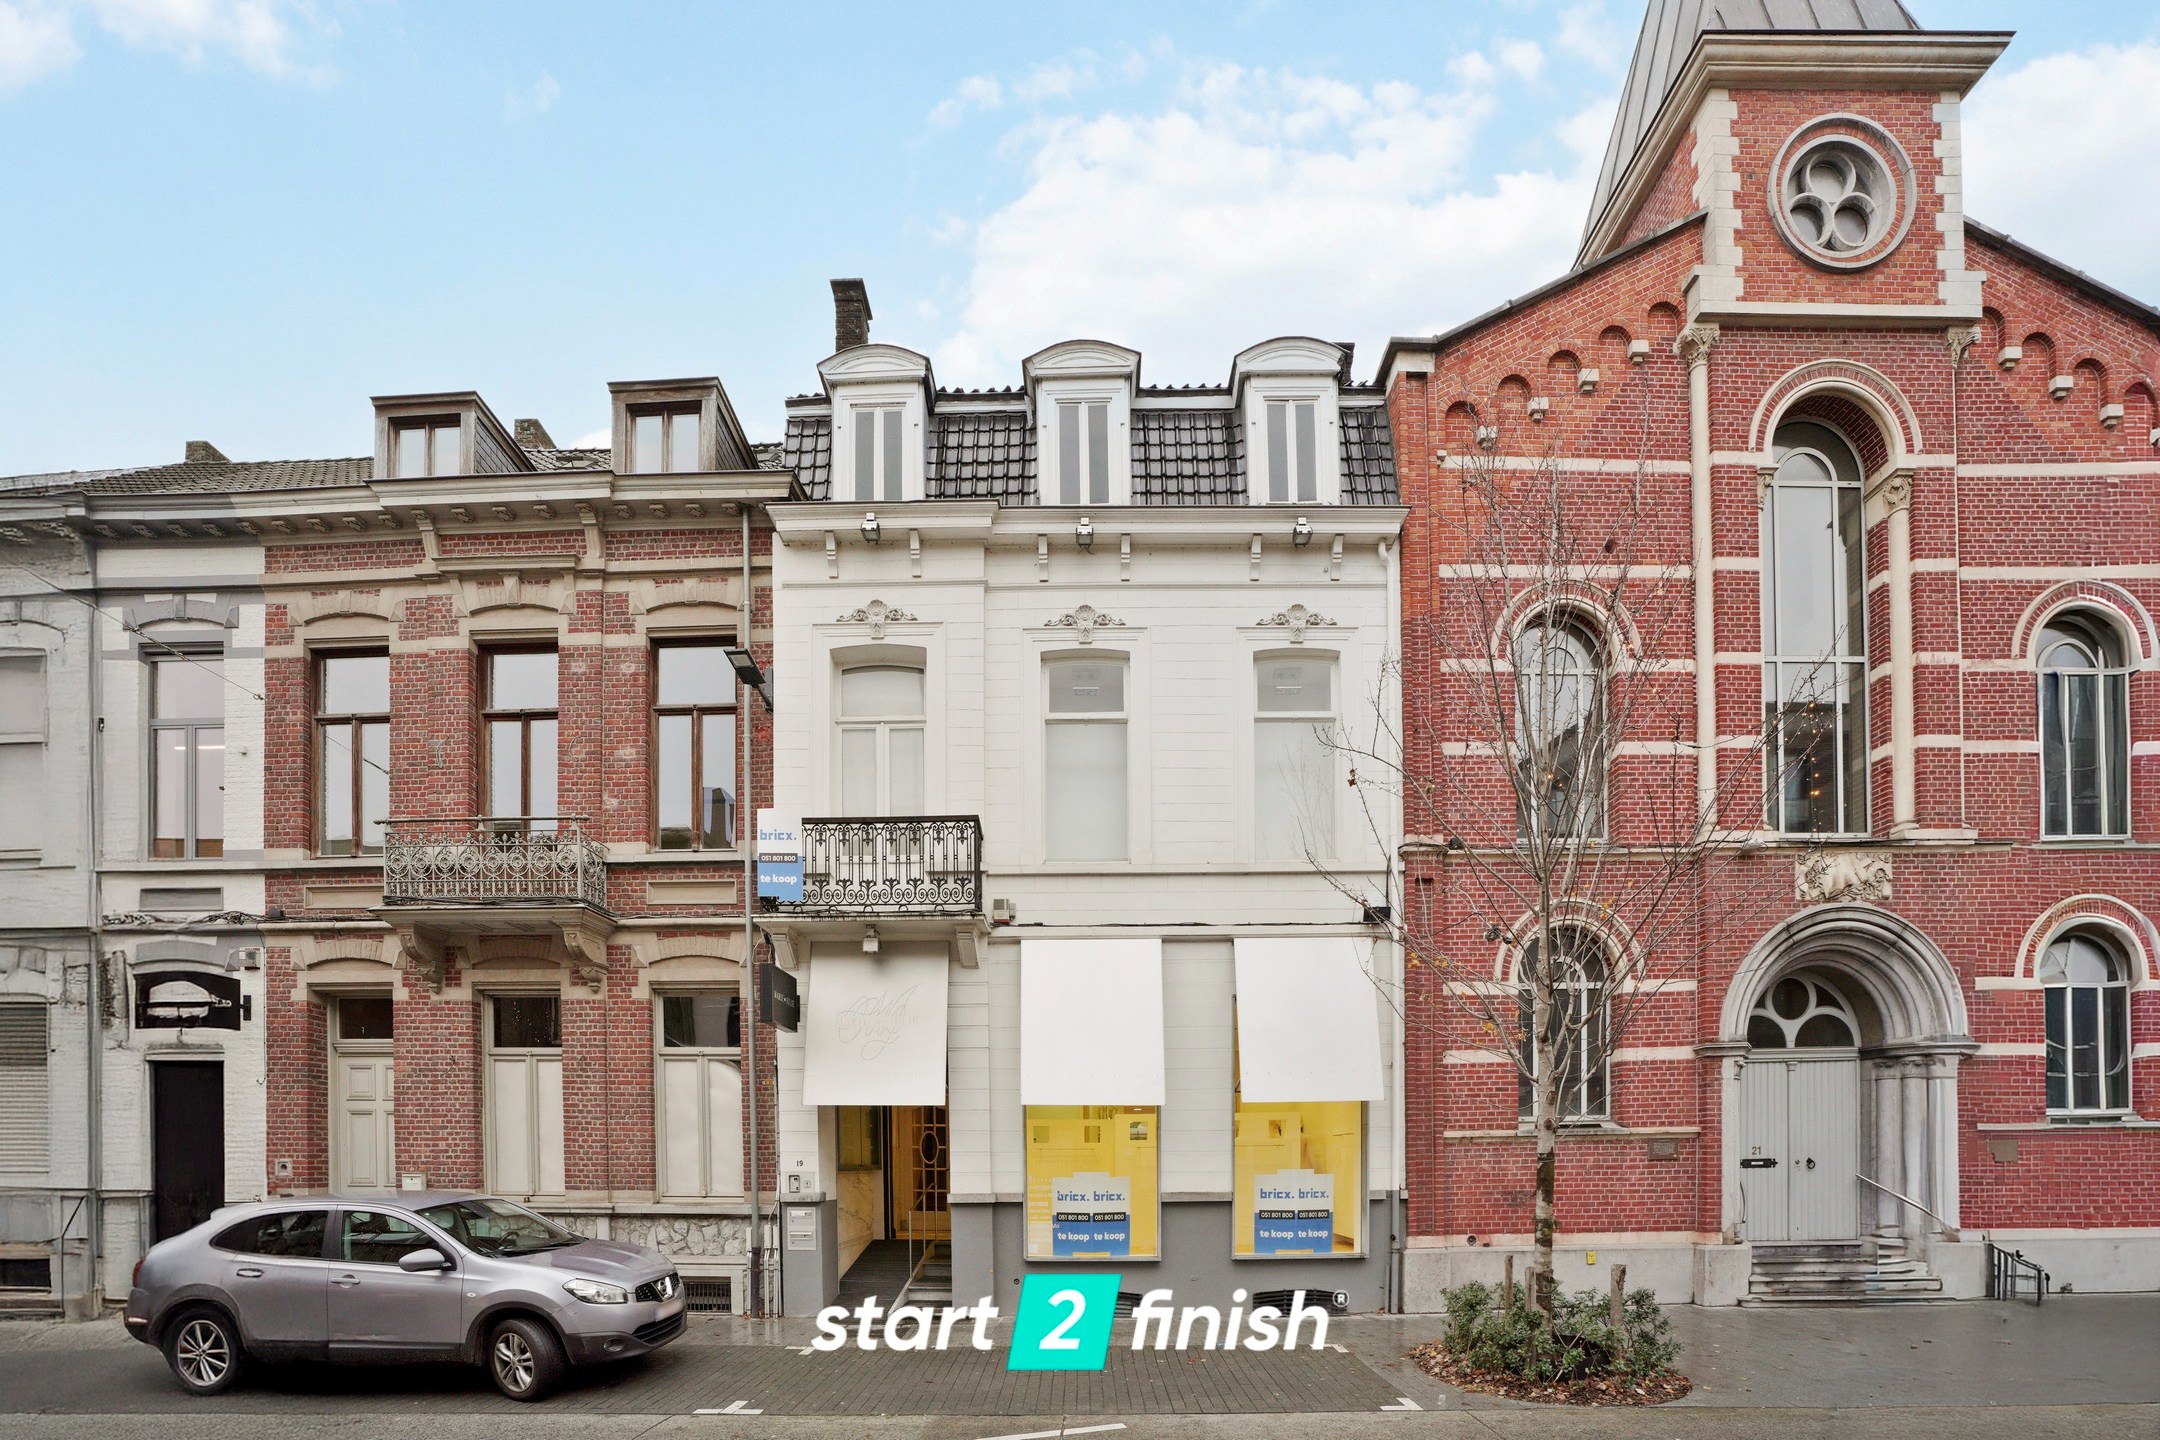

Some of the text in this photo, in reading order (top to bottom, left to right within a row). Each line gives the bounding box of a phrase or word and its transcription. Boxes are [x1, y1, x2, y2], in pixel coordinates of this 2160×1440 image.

[760, 829, 797, 840] bricx.
[760, 874, 797, 885] te koop
[1751, 1146, 1761, 1155] 21
[1093, 1190, 1125, 1201] bricx.
[1260, 1188, 1294, 1199] bricx.
[1298, 1188, 1329, 1199] bricx.
[1057, 1232, 1067, 1240] te
[1068, 1232, 1090, 1242] koop
[1093, 1232, 1125, 1241] te koop
[1260, 1229, 1294, 1240] te koop
[1298, 1229, 1328, 1239] te koop
